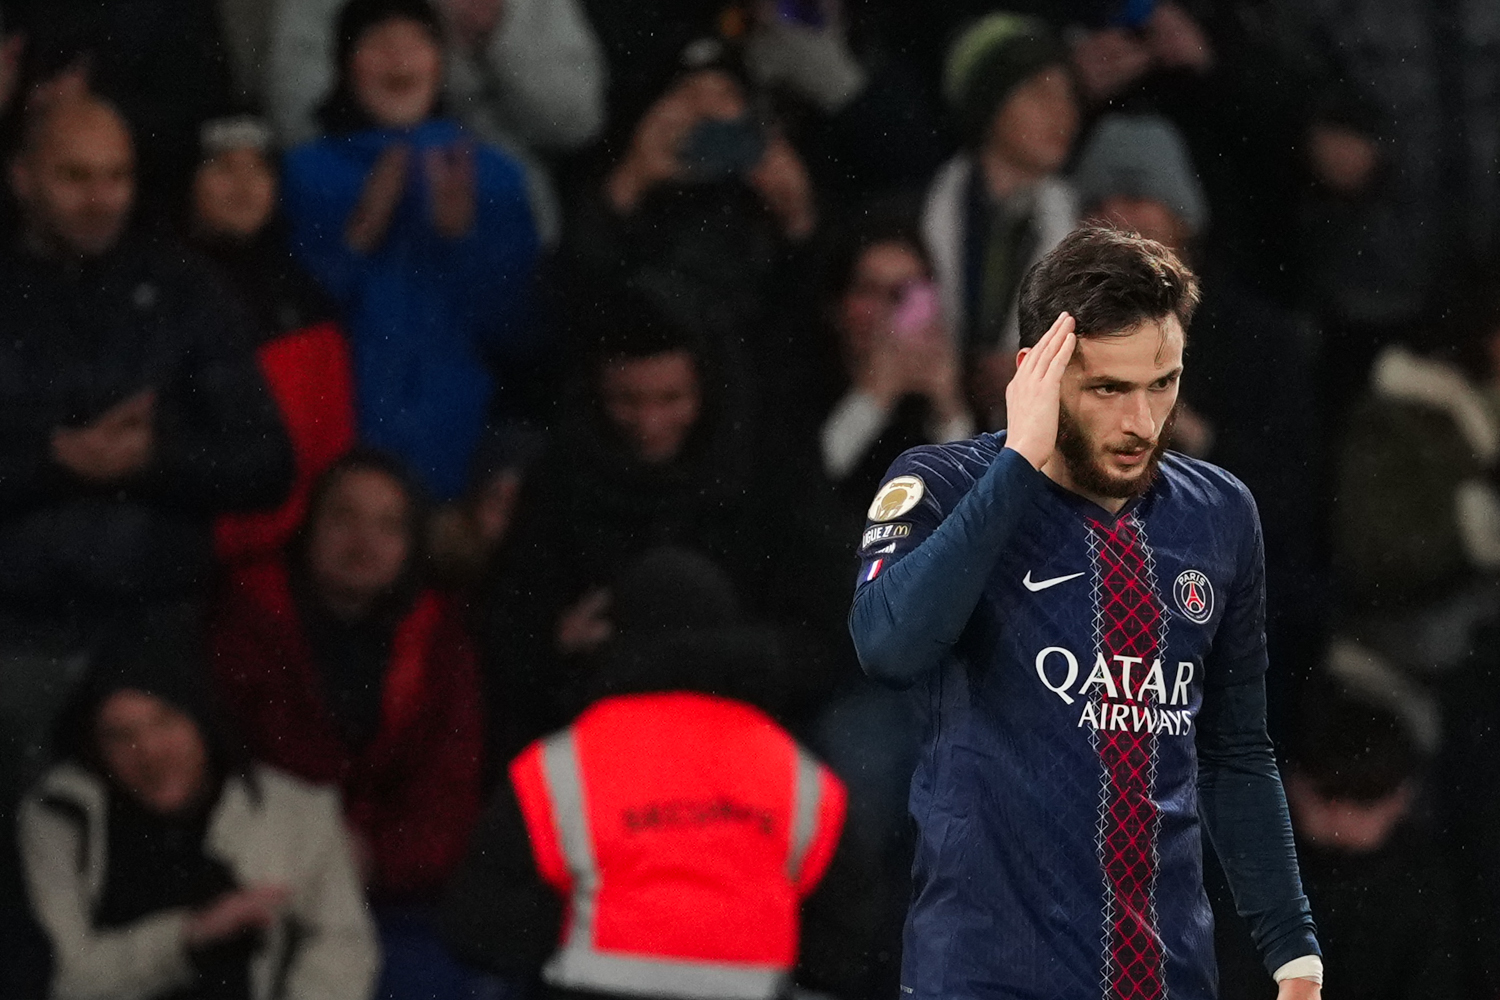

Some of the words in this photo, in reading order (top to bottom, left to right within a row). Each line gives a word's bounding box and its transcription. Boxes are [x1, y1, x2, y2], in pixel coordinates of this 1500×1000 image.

[1178, 572, 1206, 586] PARIS
[1035, 646, 1194, 705] QATAR
[1077, 701, 1192, 736] AIRWAYS
